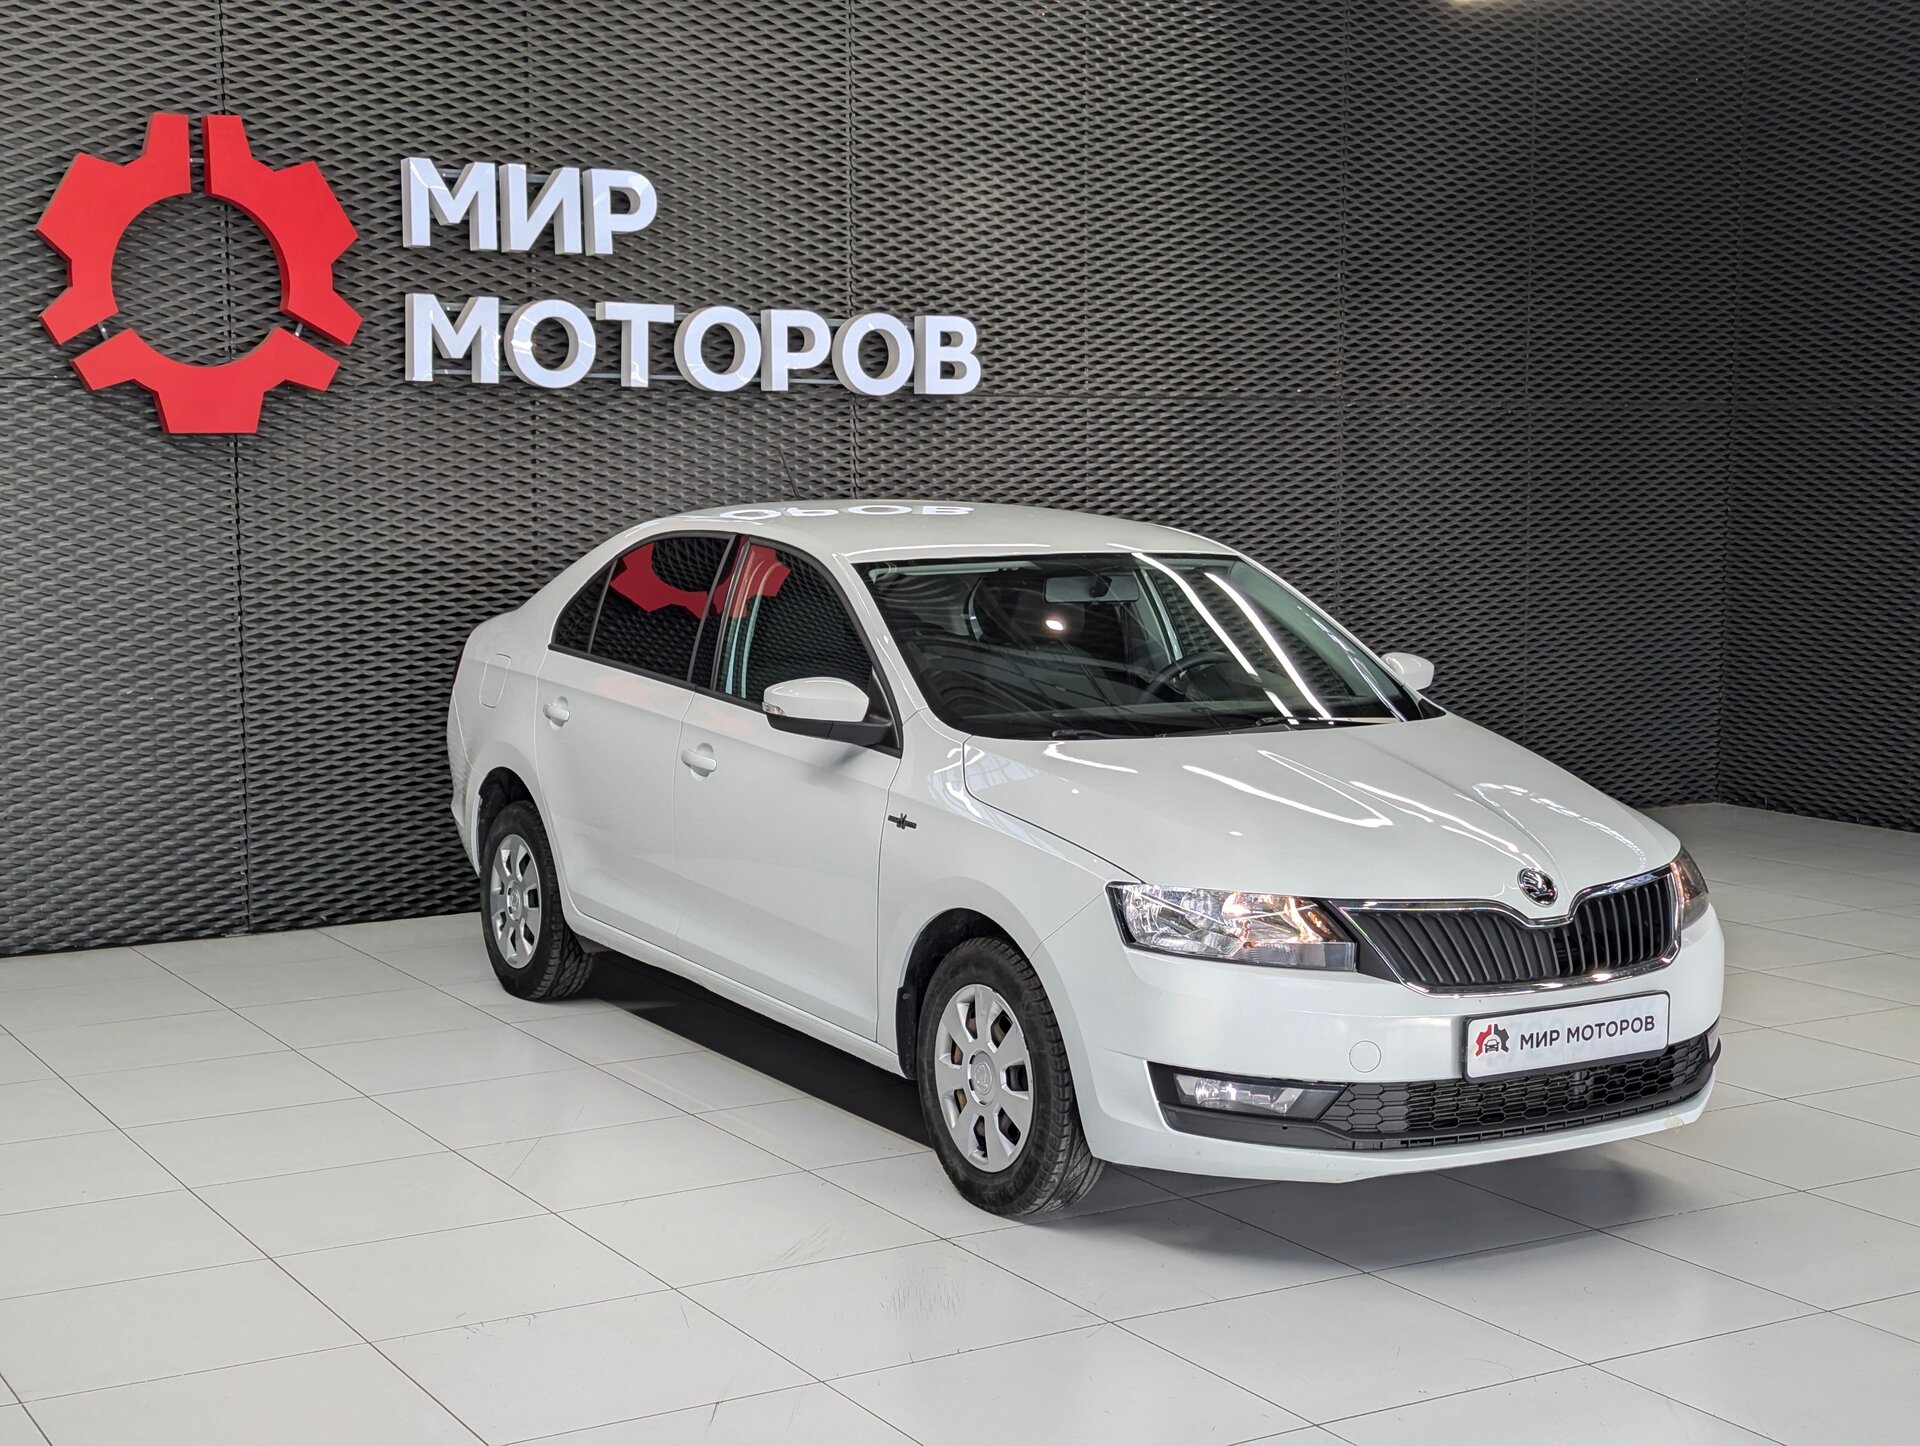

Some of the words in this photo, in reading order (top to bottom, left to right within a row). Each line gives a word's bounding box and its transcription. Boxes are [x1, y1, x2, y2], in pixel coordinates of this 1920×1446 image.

[401, 157, 658, 255] МИР
[404, 293, 982, 396] МОТОРОВ
[1520, 1029, 1560, 1050] МИР
[1566, 1015, 1655, 1044] МОТОРОВ
